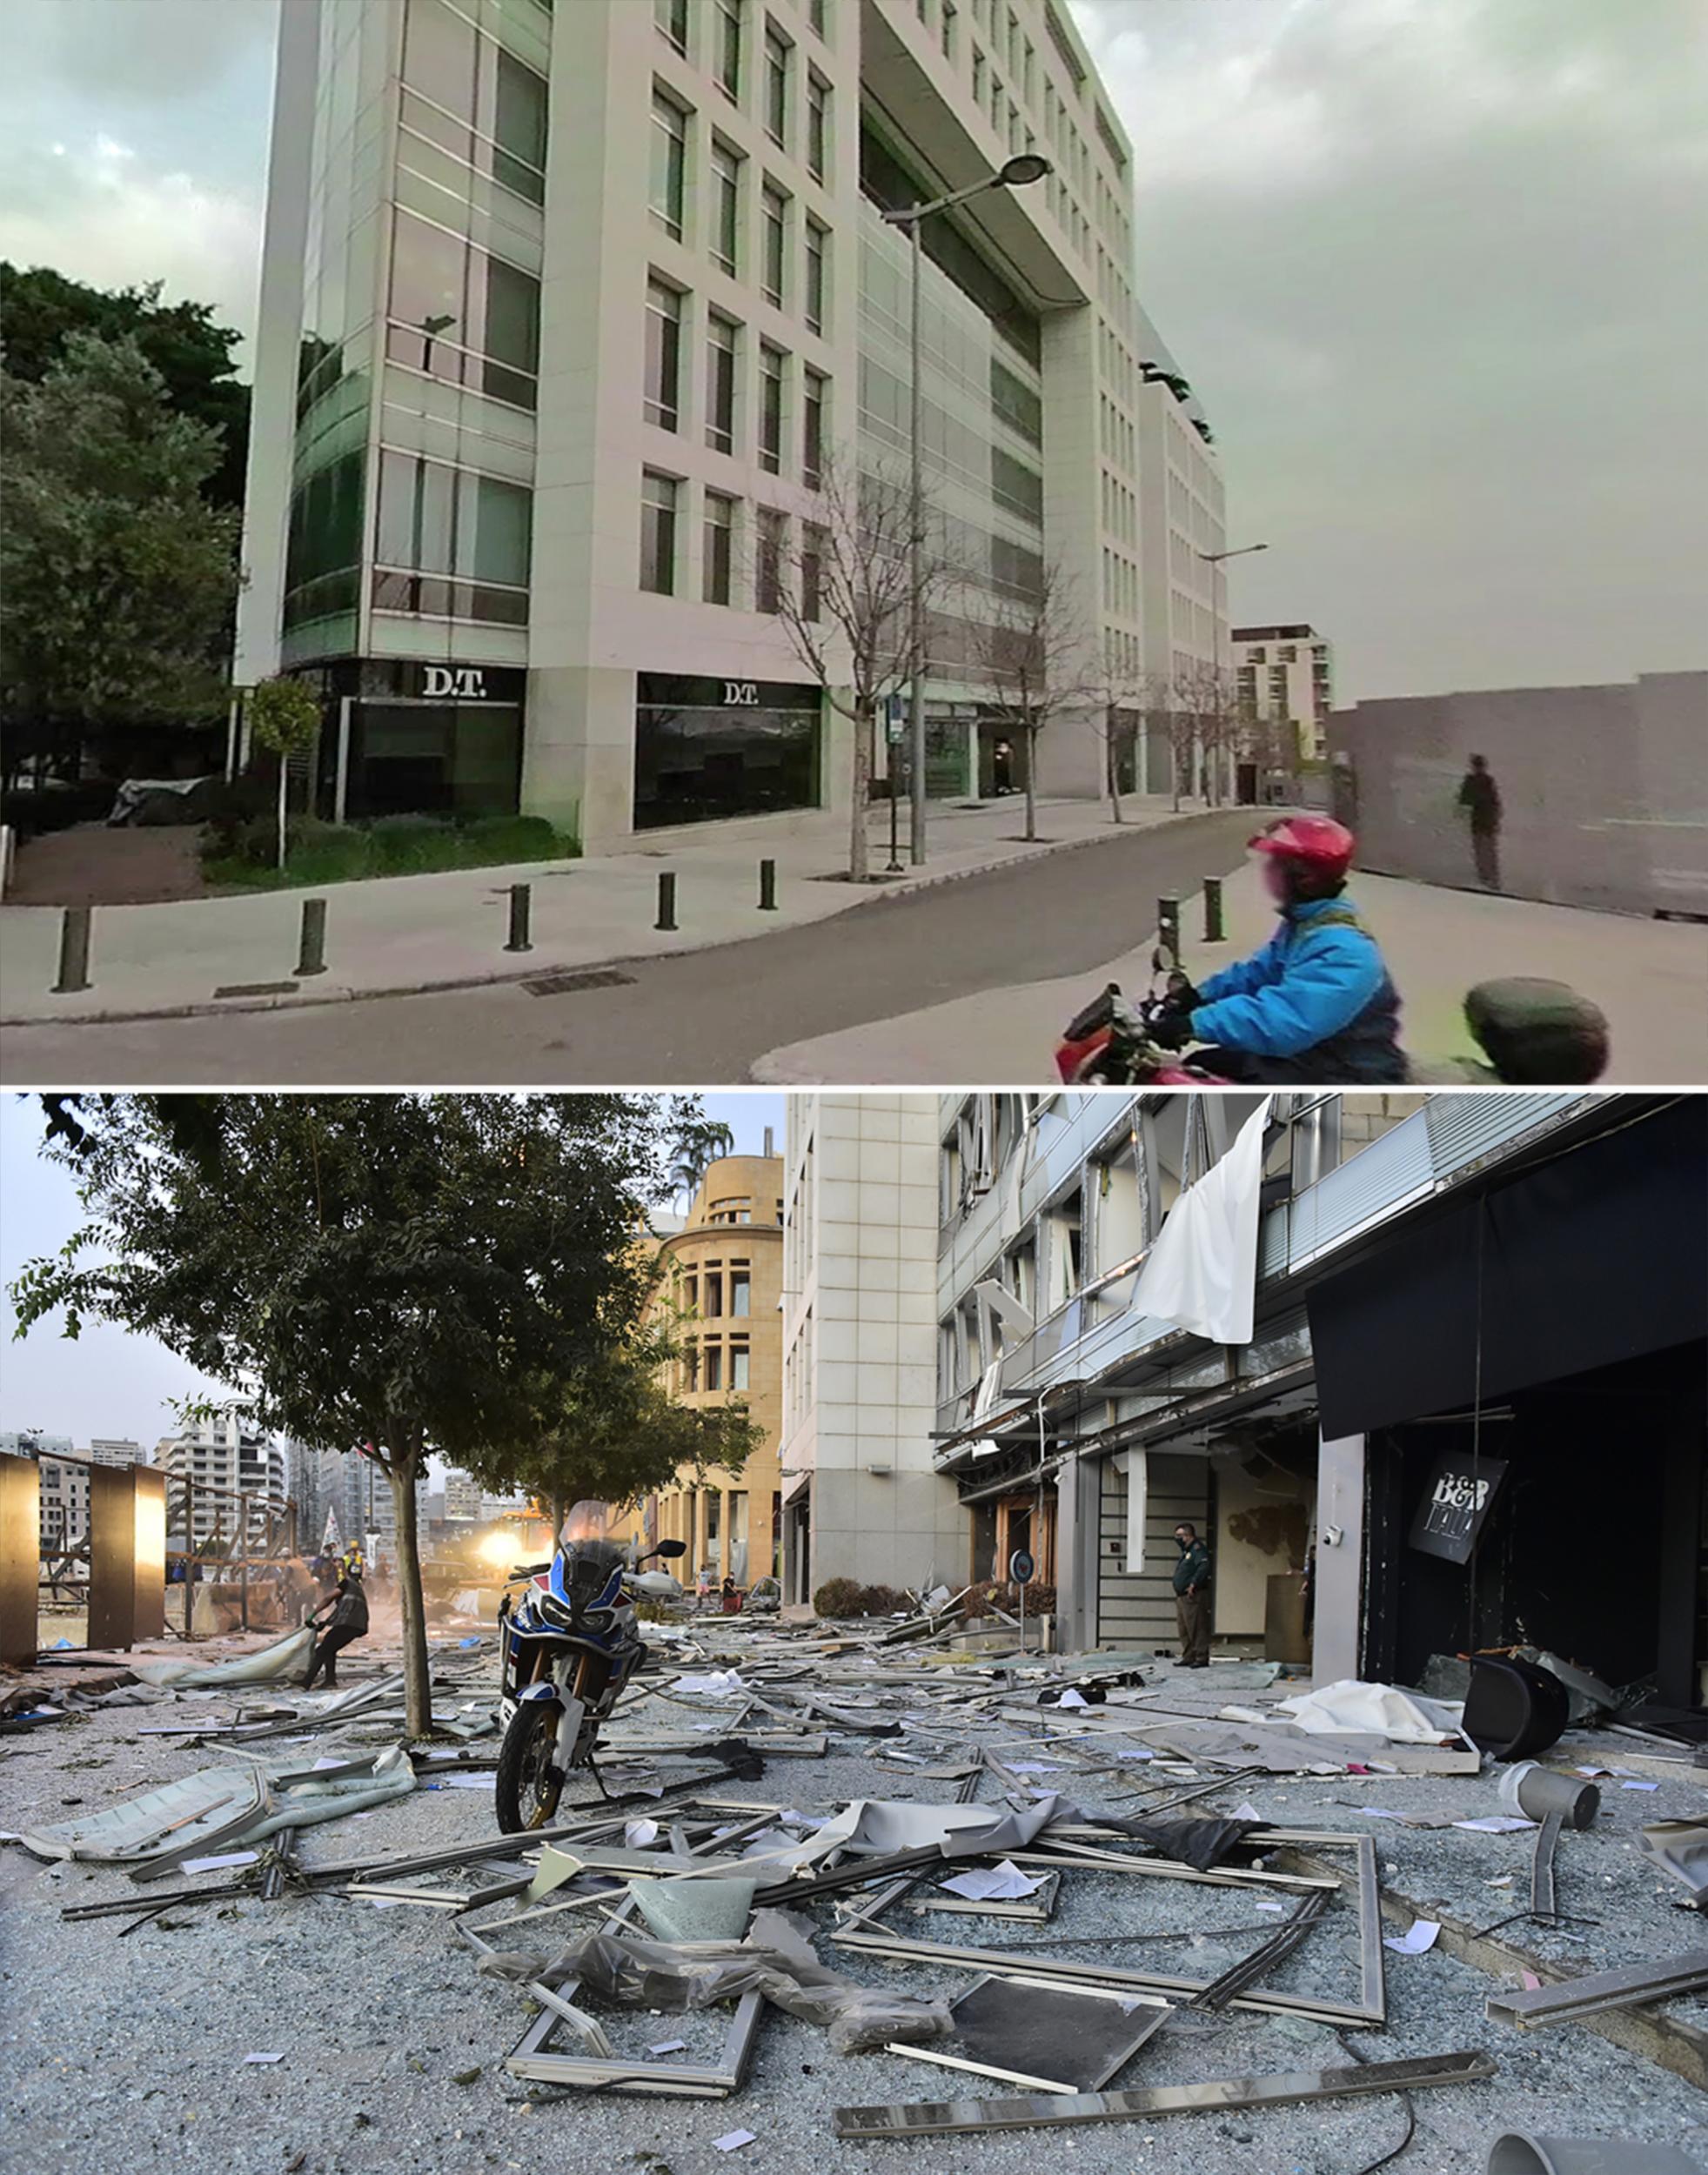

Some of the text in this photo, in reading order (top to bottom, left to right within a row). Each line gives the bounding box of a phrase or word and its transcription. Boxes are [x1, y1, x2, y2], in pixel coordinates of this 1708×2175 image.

[422, 666, 487, 698] D.T.
[723, 682, 759, 705] D.T.
[1431, 1472, 1490, 1512] B&B
